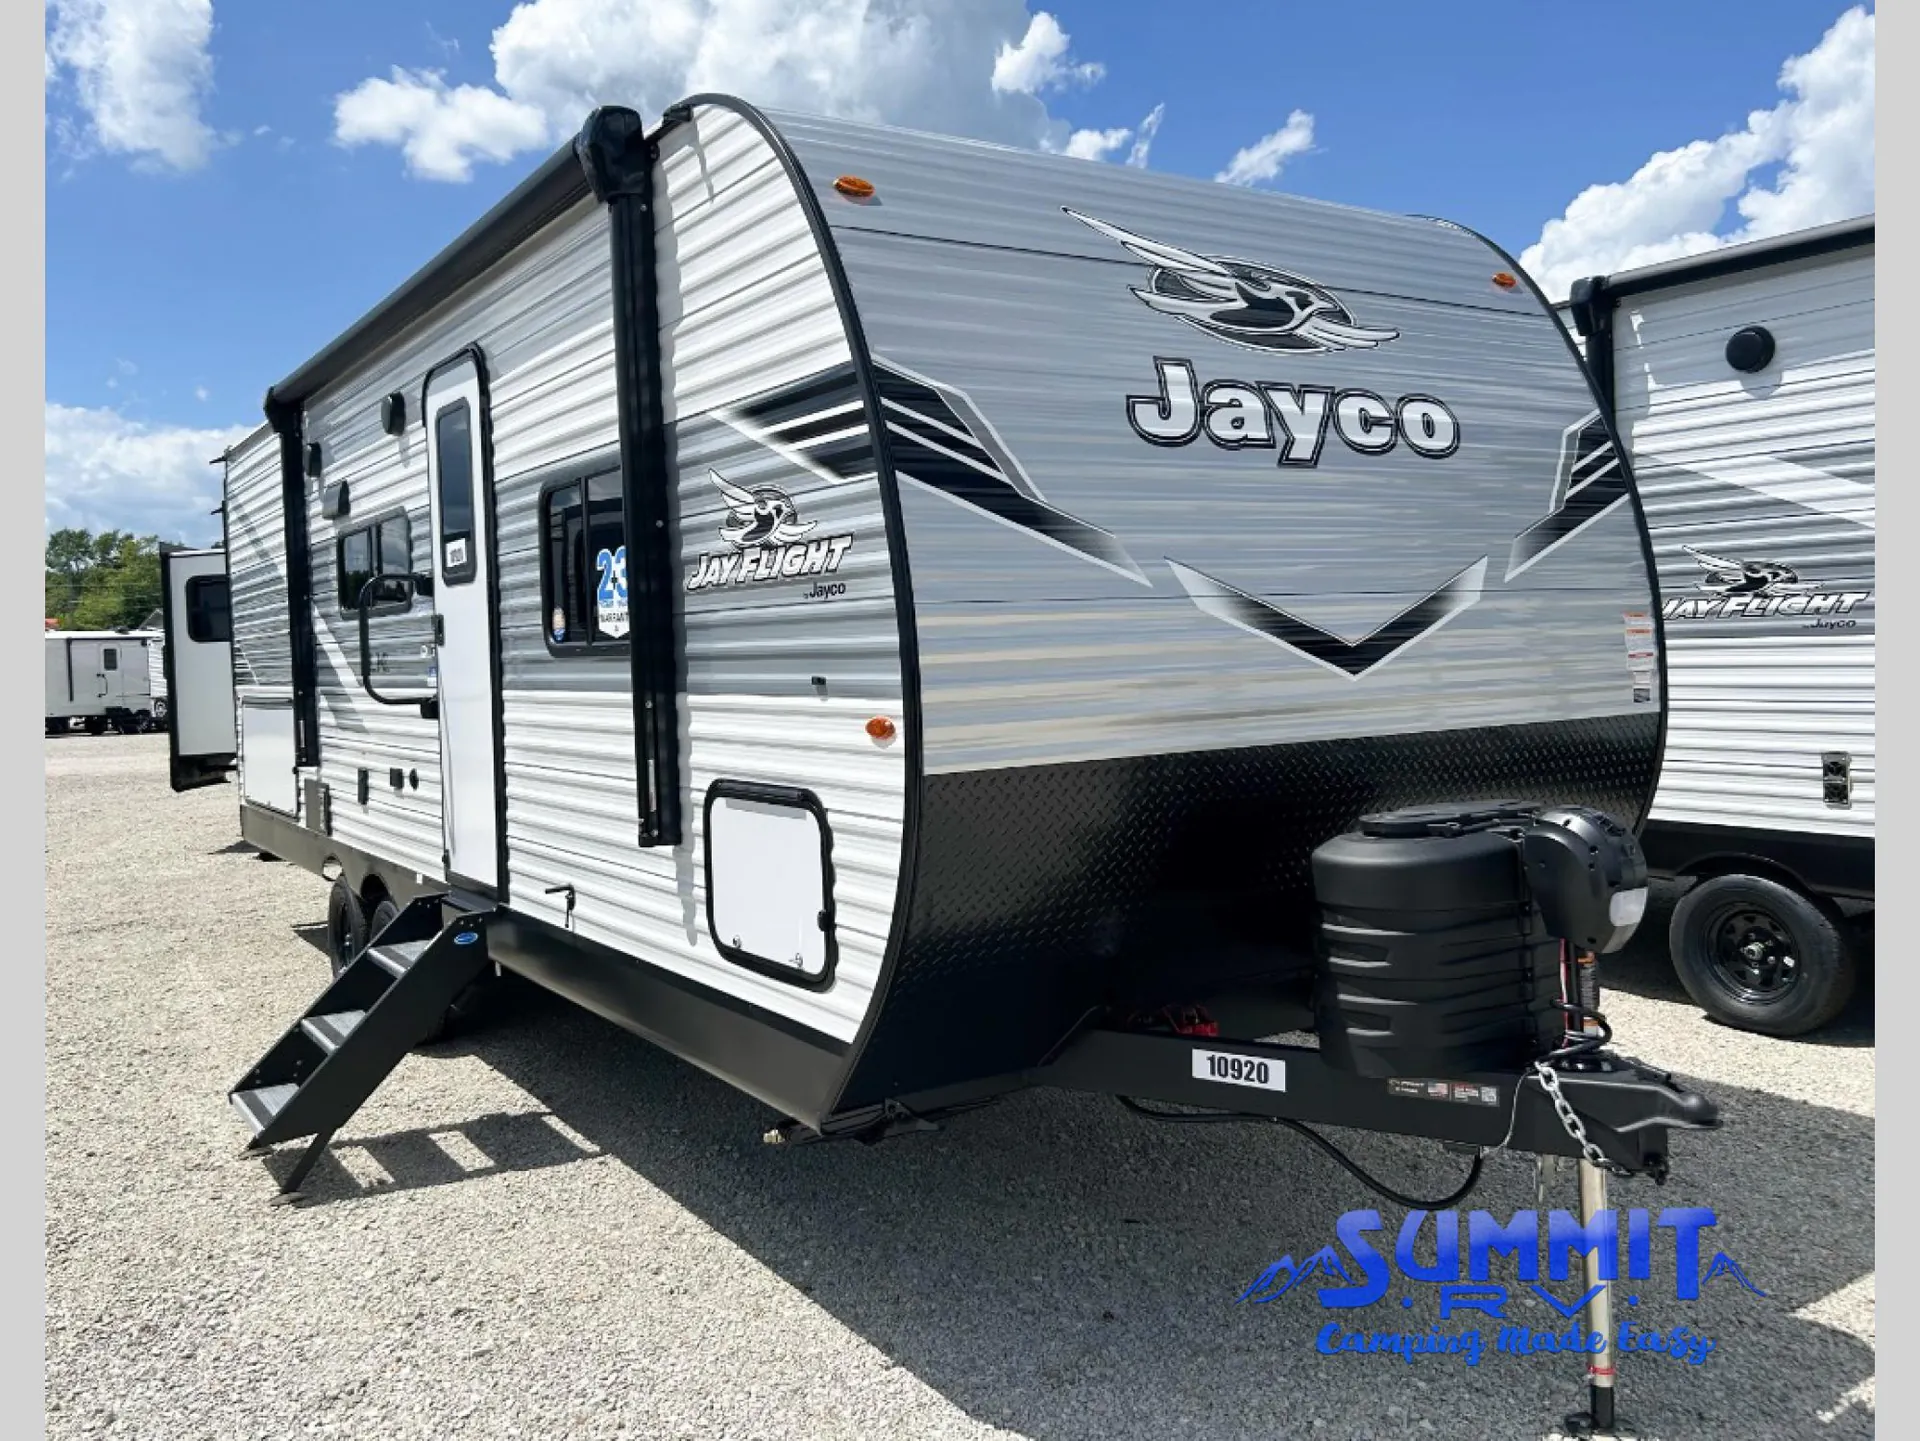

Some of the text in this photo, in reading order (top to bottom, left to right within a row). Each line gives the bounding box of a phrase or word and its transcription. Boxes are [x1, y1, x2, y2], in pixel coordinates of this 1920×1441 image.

[1125, 355, 1461, 469] Jayco
[687, 532, 854, 590] JAY FLIGHT
[809, 581, 846, 599] Jayco
[1716, 591, 1870, 618] FLIGHT
[1810, 619, 1857, 630] Jayco
[1206, 1054, 1270, 1085] 10920
